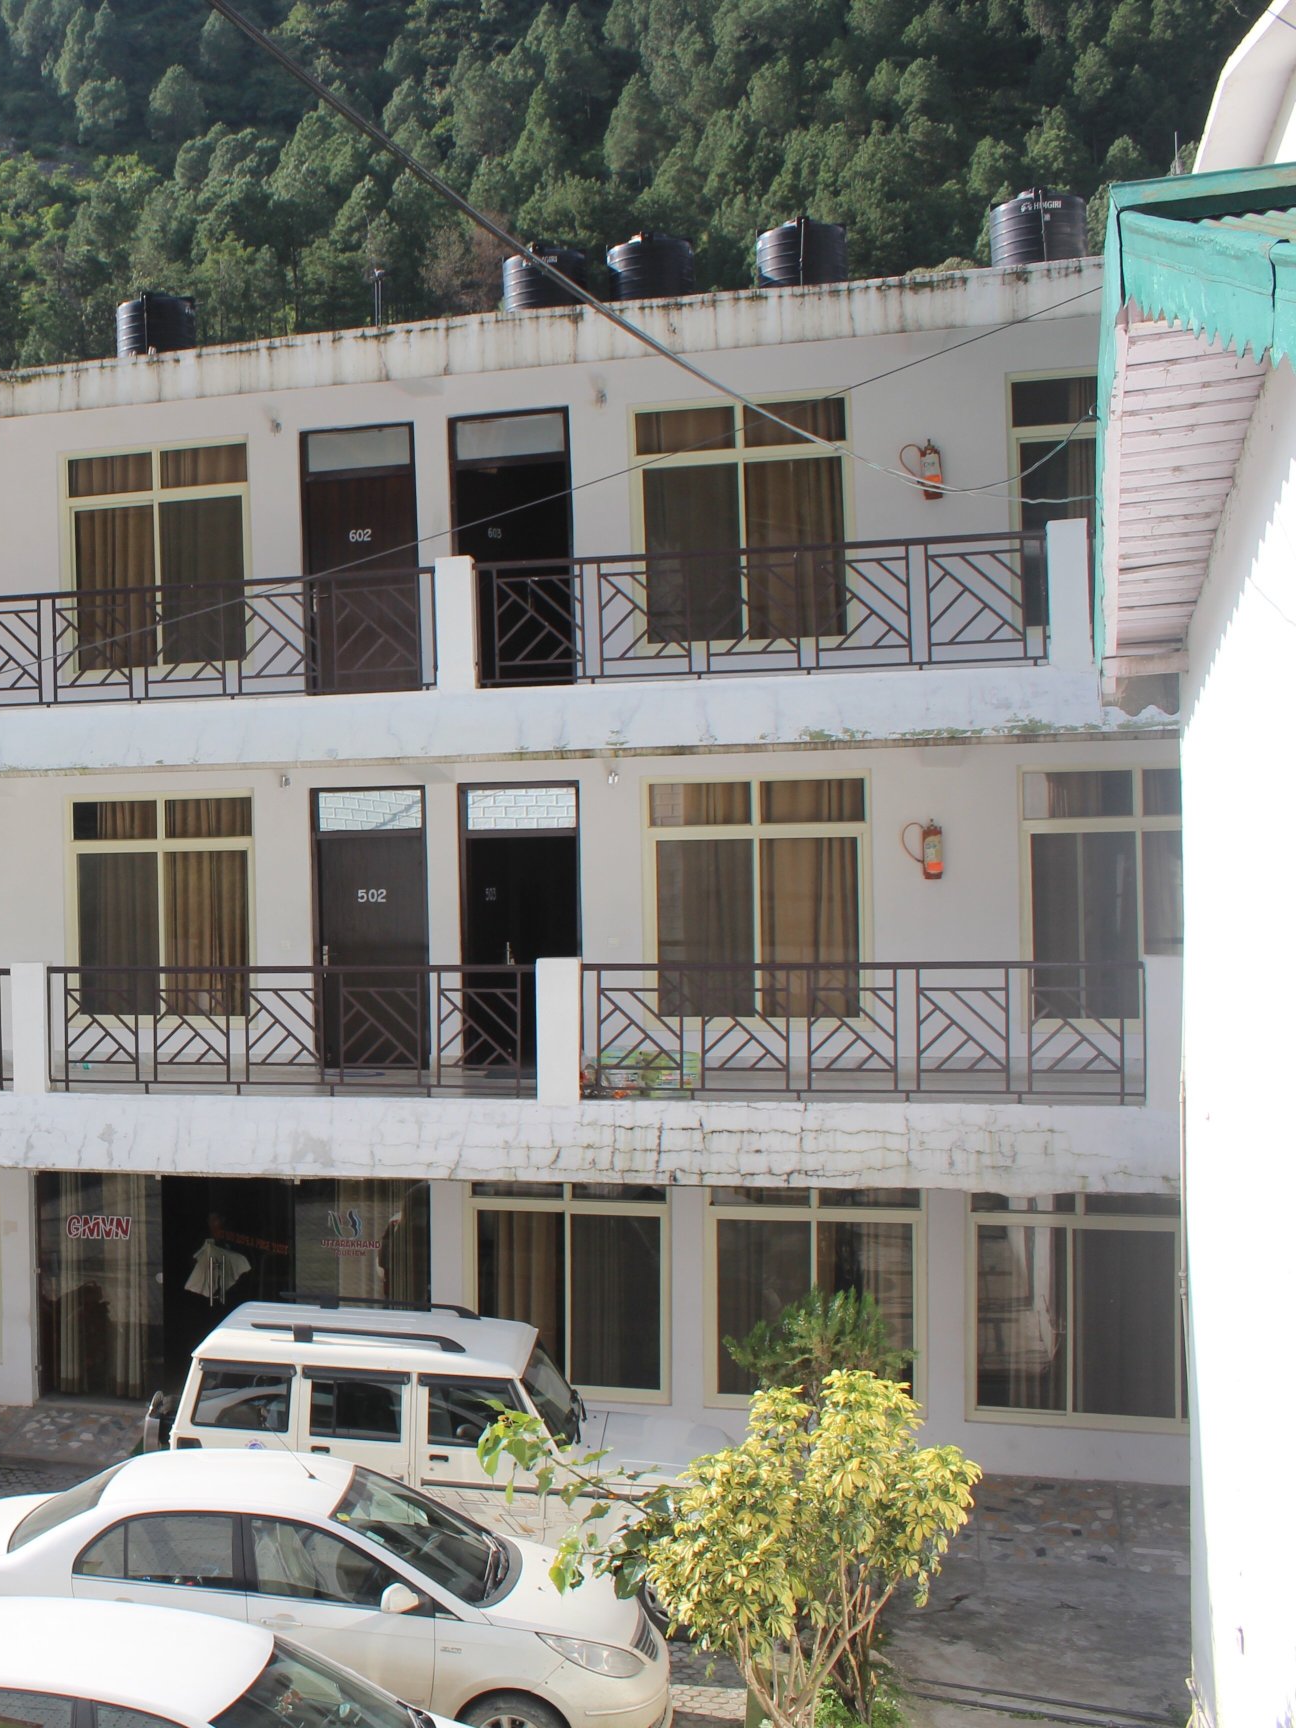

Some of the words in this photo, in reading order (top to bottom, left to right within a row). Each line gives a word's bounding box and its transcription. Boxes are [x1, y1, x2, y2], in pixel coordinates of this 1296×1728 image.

[349, 529, 372, 542] 602
[487, 527, 502, 539] 603
[357, 889, 387, 903] 502
[66, 1214, 132, 1240] GMVN
[320, 1239, 381, 1250] UTTARAKHAND
